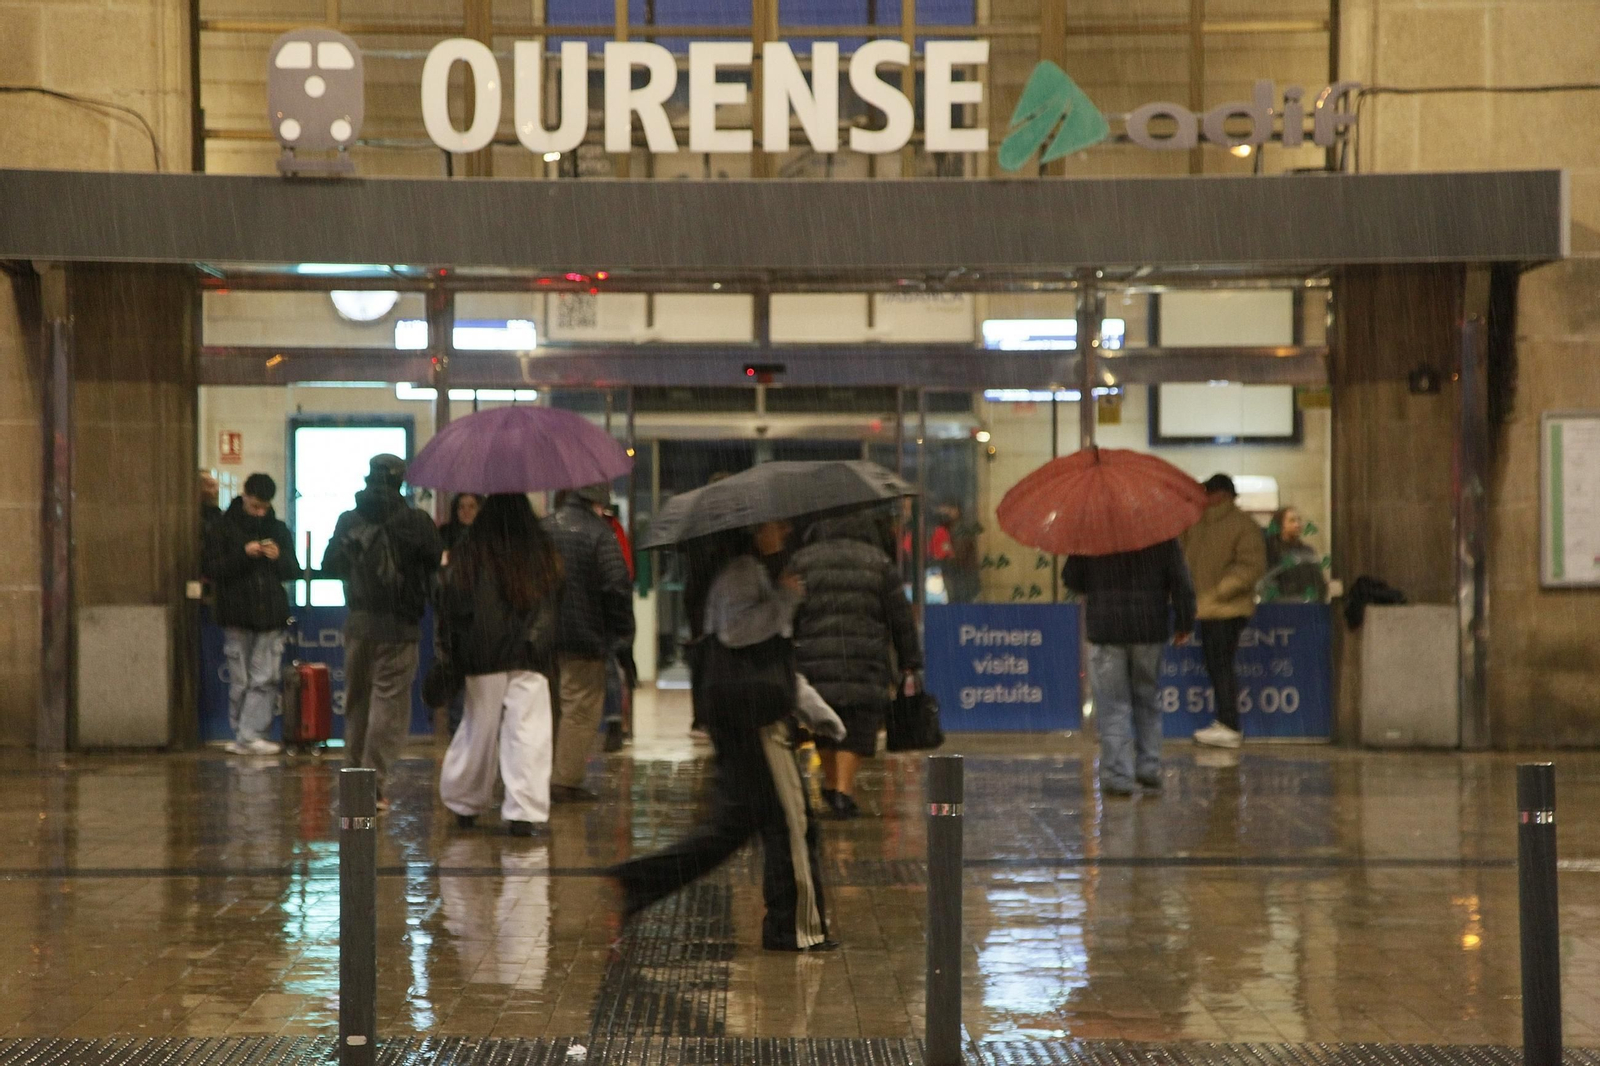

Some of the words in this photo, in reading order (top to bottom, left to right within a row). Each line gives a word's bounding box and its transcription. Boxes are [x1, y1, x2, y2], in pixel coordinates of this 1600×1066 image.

[421, 38, 990, 153] OURENSE
[1125, 79, 1362, 151] adif
[959, 624, 1042, 647] Primera
[973, 653, 1029, 675] visita
[960, 682, 1042, 710] gratuita
[1186, 686, 1216, 713] 51
[1260, 686, 1300, 714] 00
